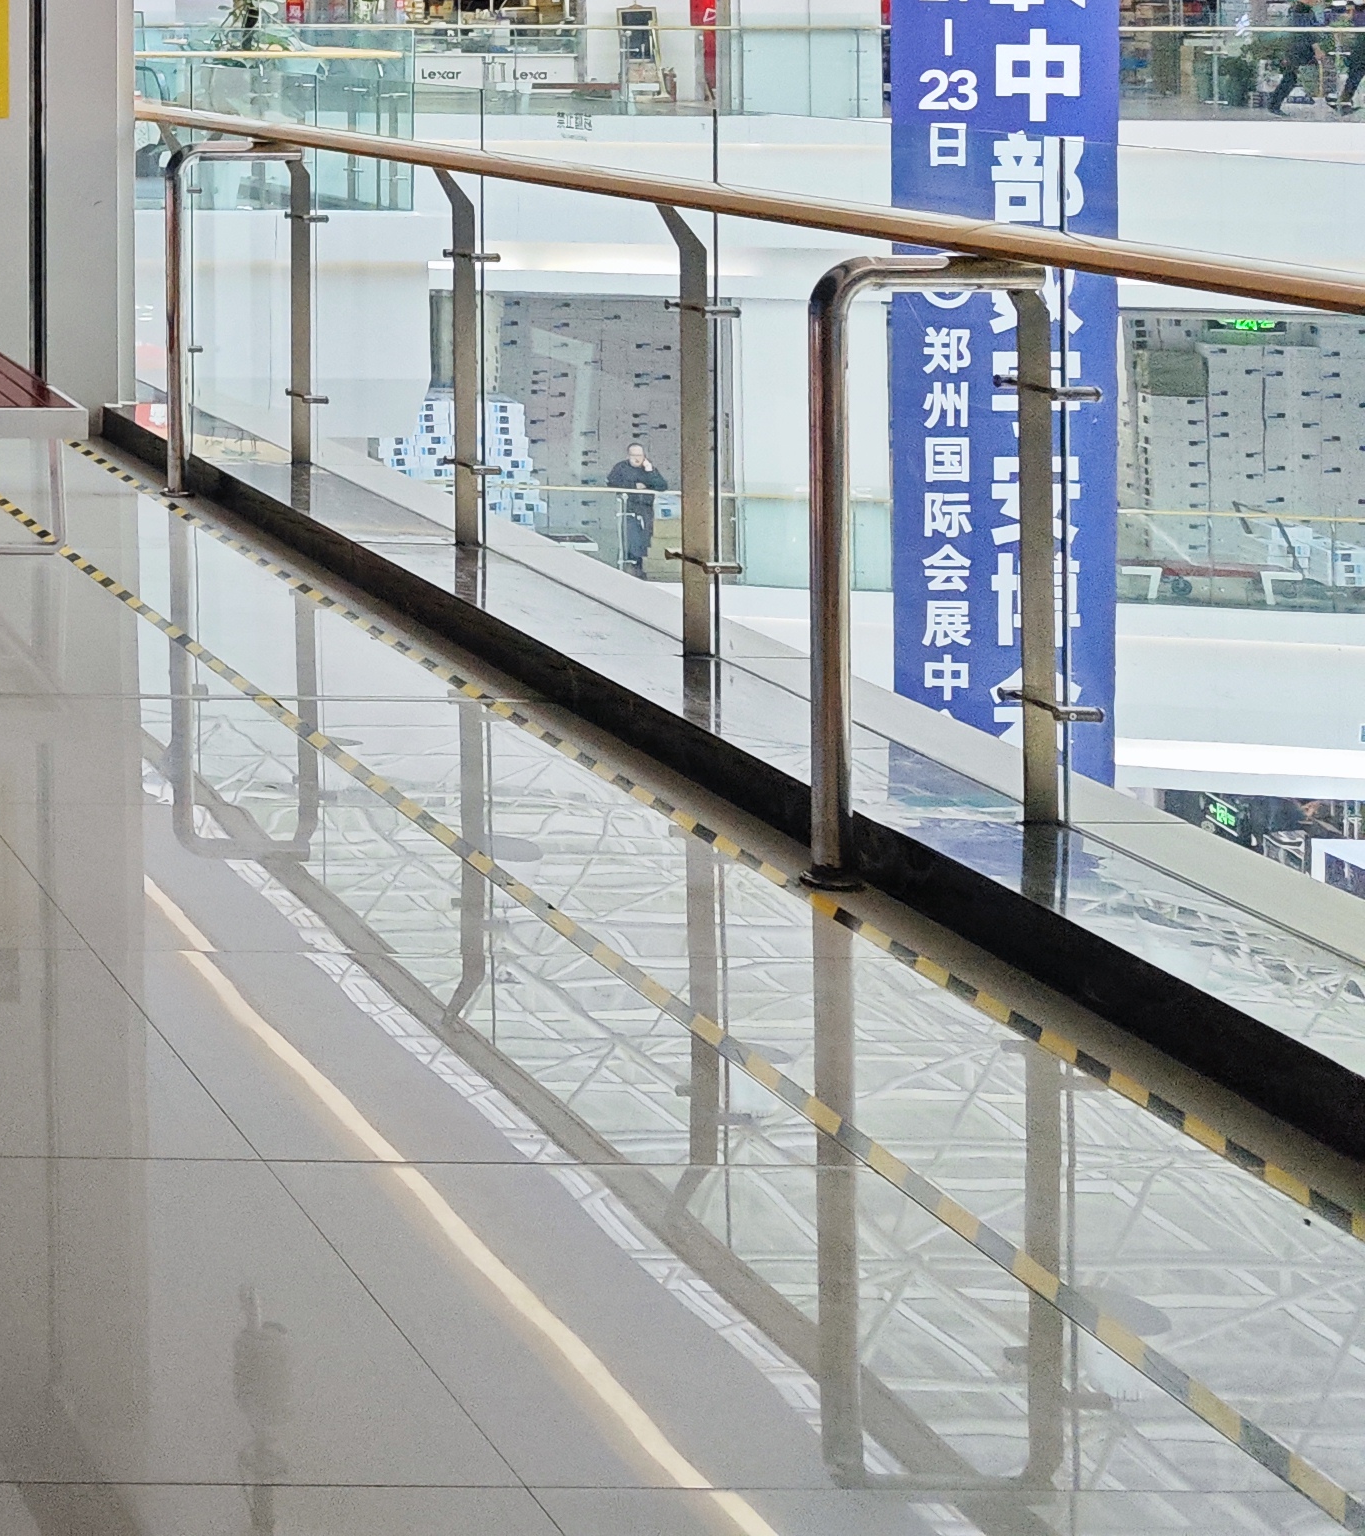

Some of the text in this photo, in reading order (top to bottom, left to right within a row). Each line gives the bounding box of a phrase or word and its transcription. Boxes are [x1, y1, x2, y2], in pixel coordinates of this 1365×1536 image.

[420, 68, 462, 81] Lexar
[921, 327, 973, 728] 郑州国际会展中
